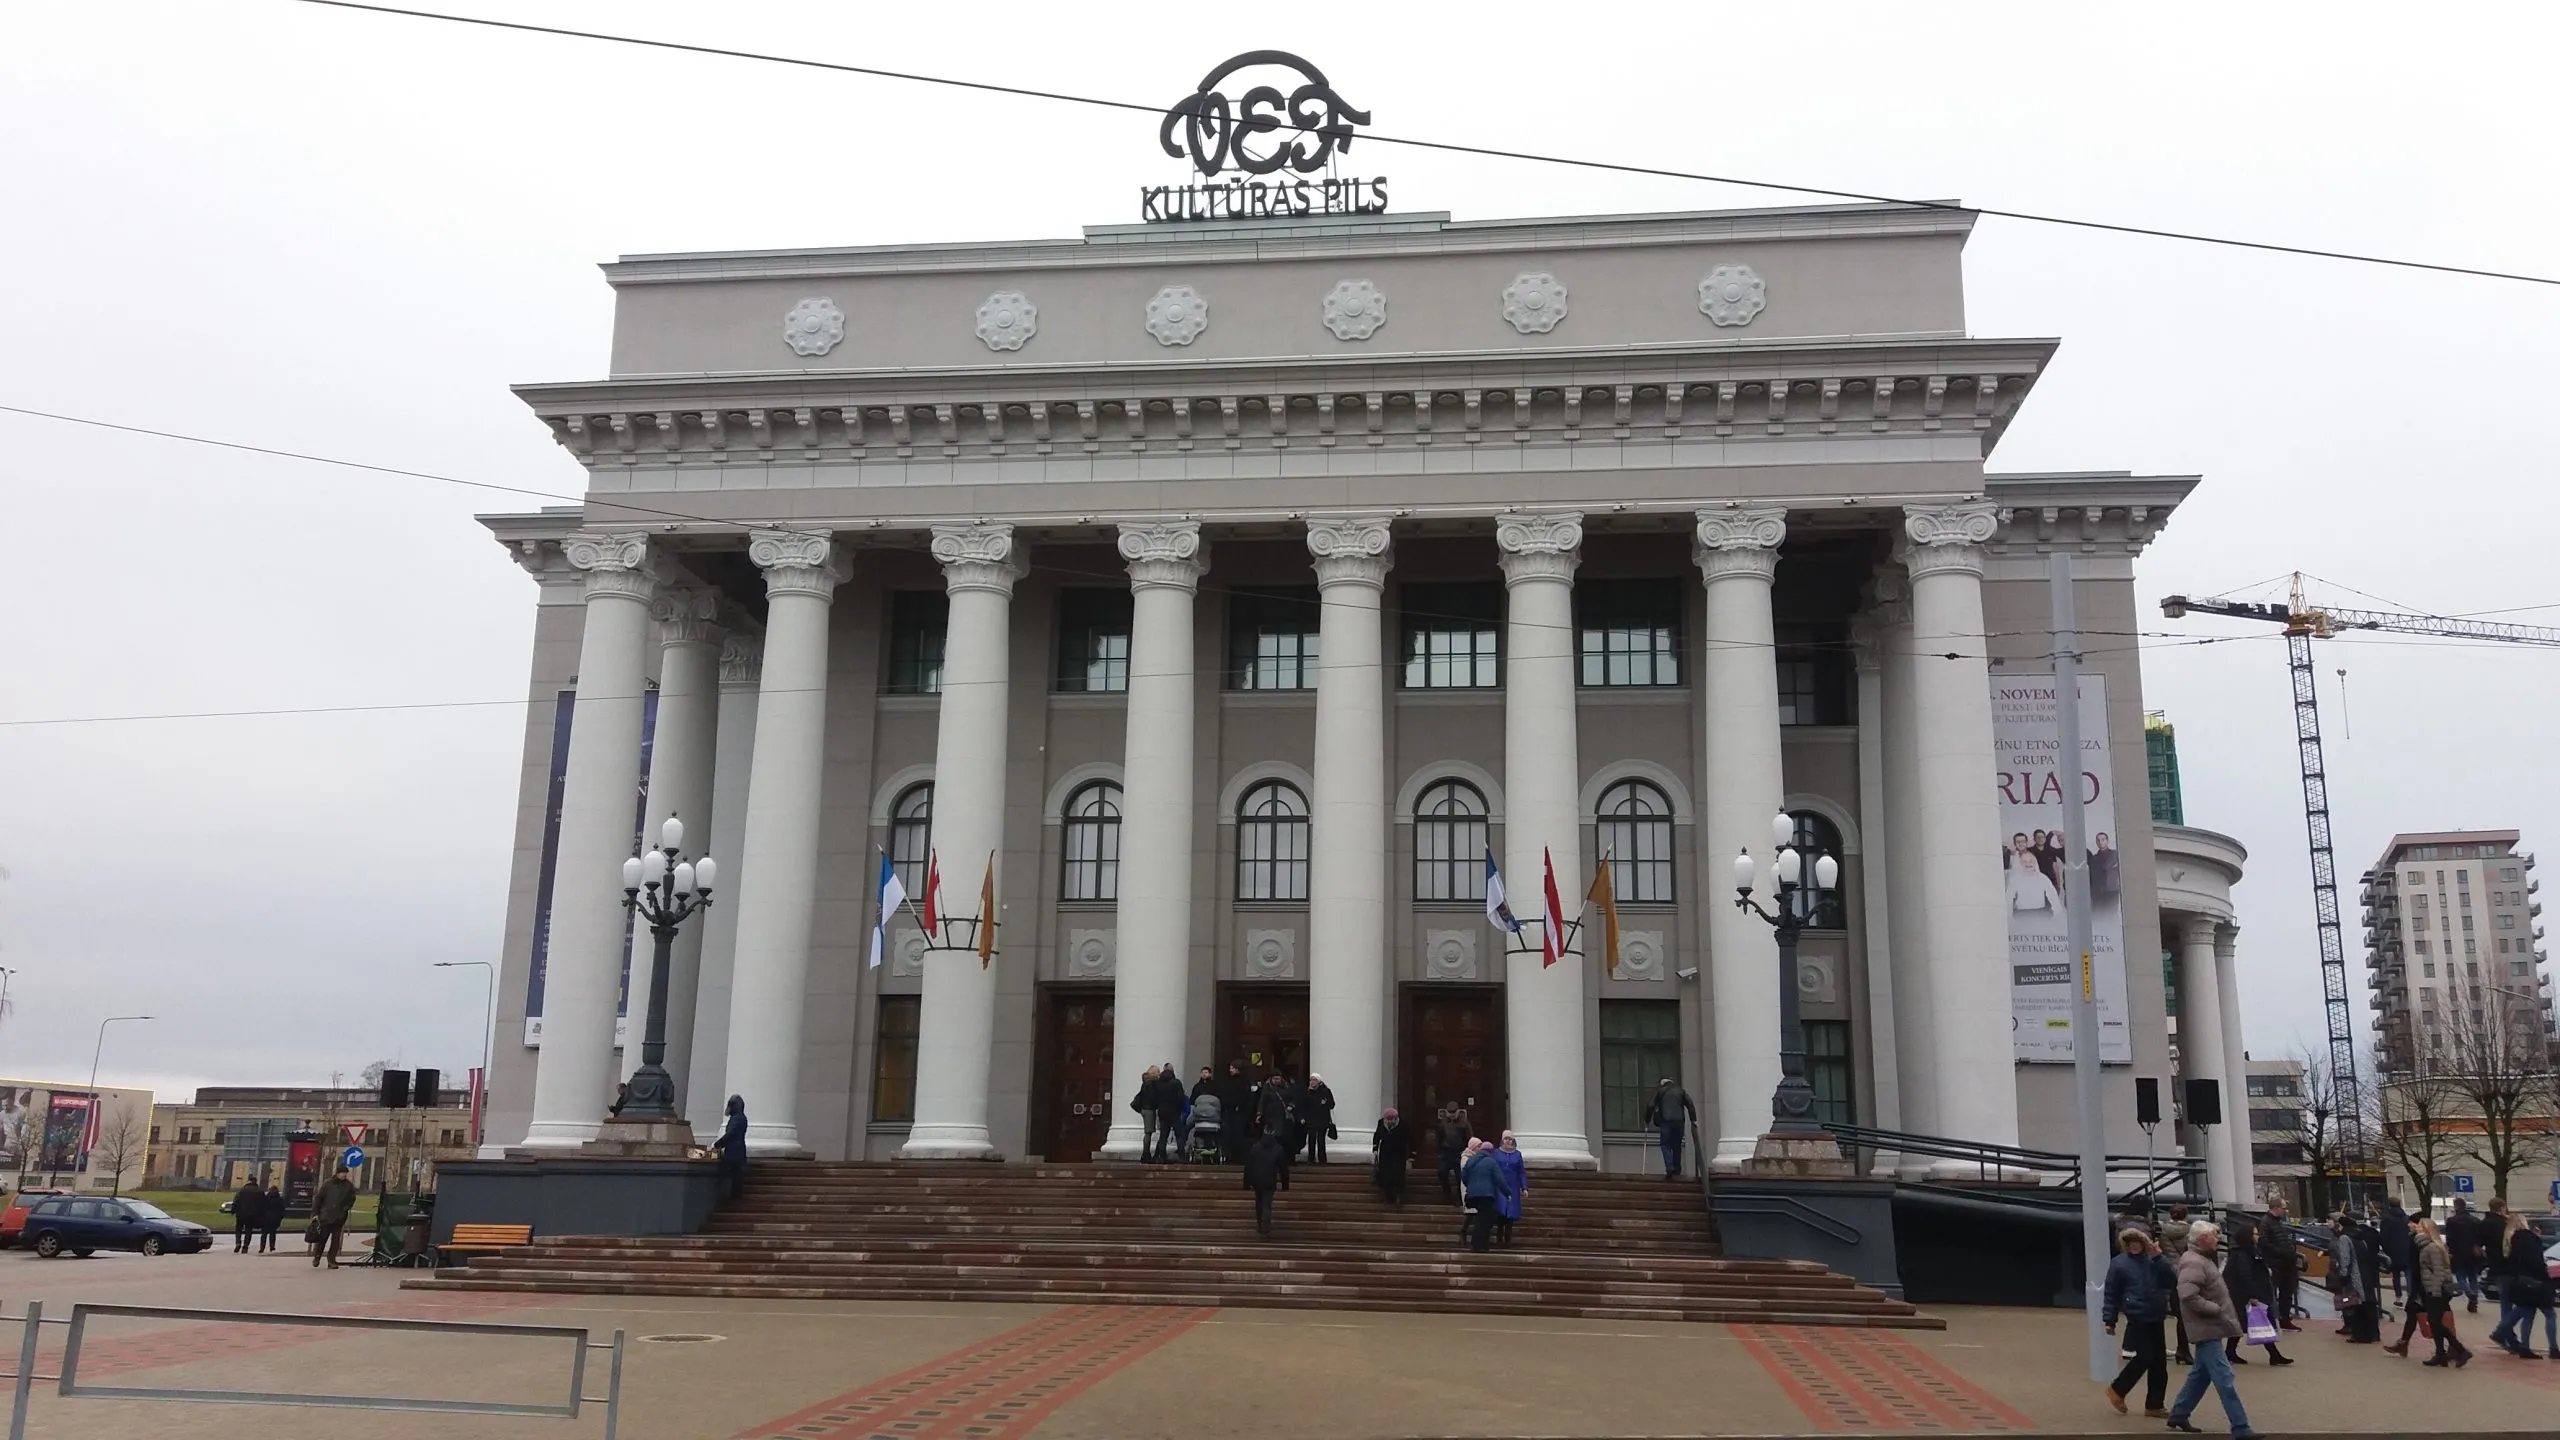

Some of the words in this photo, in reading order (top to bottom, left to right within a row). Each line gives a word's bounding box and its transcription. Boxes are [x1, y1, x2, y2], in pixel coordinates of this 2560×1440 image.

[1141, 177, 1311, 221] KULTŪRAS
[1322, 176, 1388, 216] PILS
[2013, 755, 2055, 765] GRUPA
[2459, 1178, 2470, 1191] P
